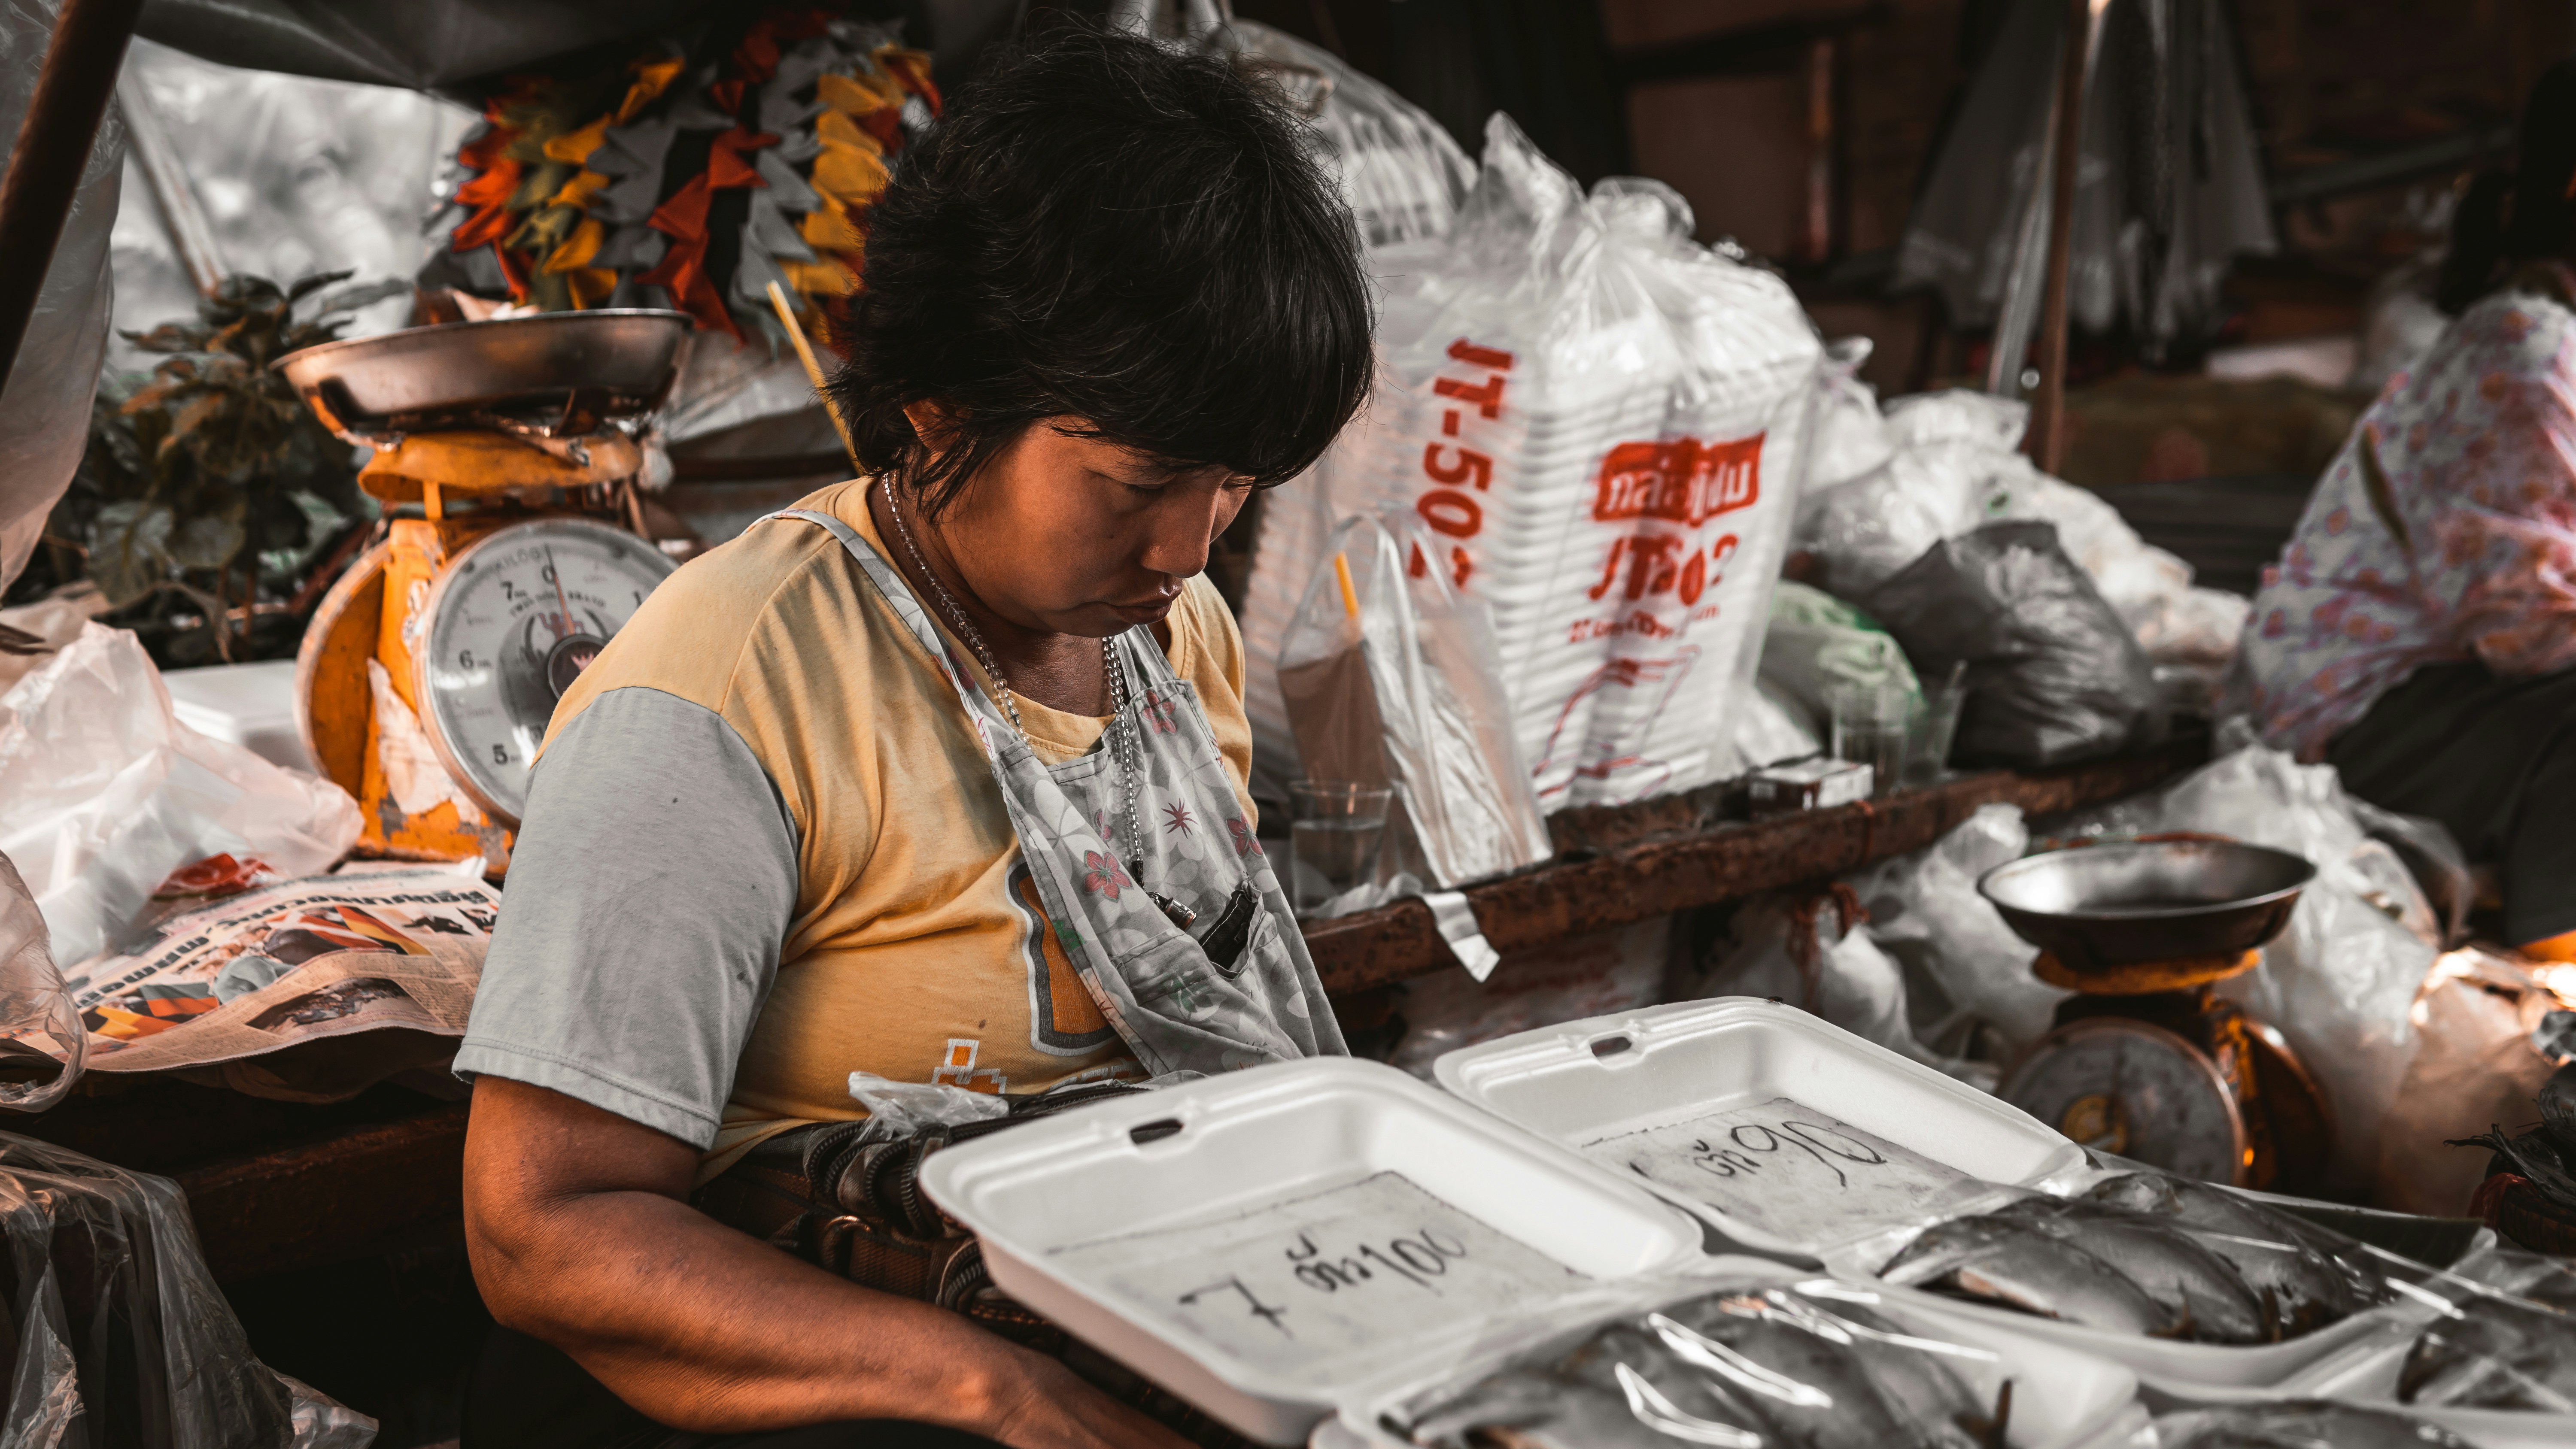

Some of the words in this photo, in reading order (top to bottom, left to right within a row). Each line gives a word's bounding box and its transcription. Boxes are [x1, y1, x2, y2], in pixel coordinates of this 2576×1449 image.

[499, 580, 513, 601] 7
[459, 649, 475, 672] 6
[492, 744, 508, 766] 5
[1731, 1121, 1886, 1188] 90
[1178, 1273, 1292, 1340] 7
